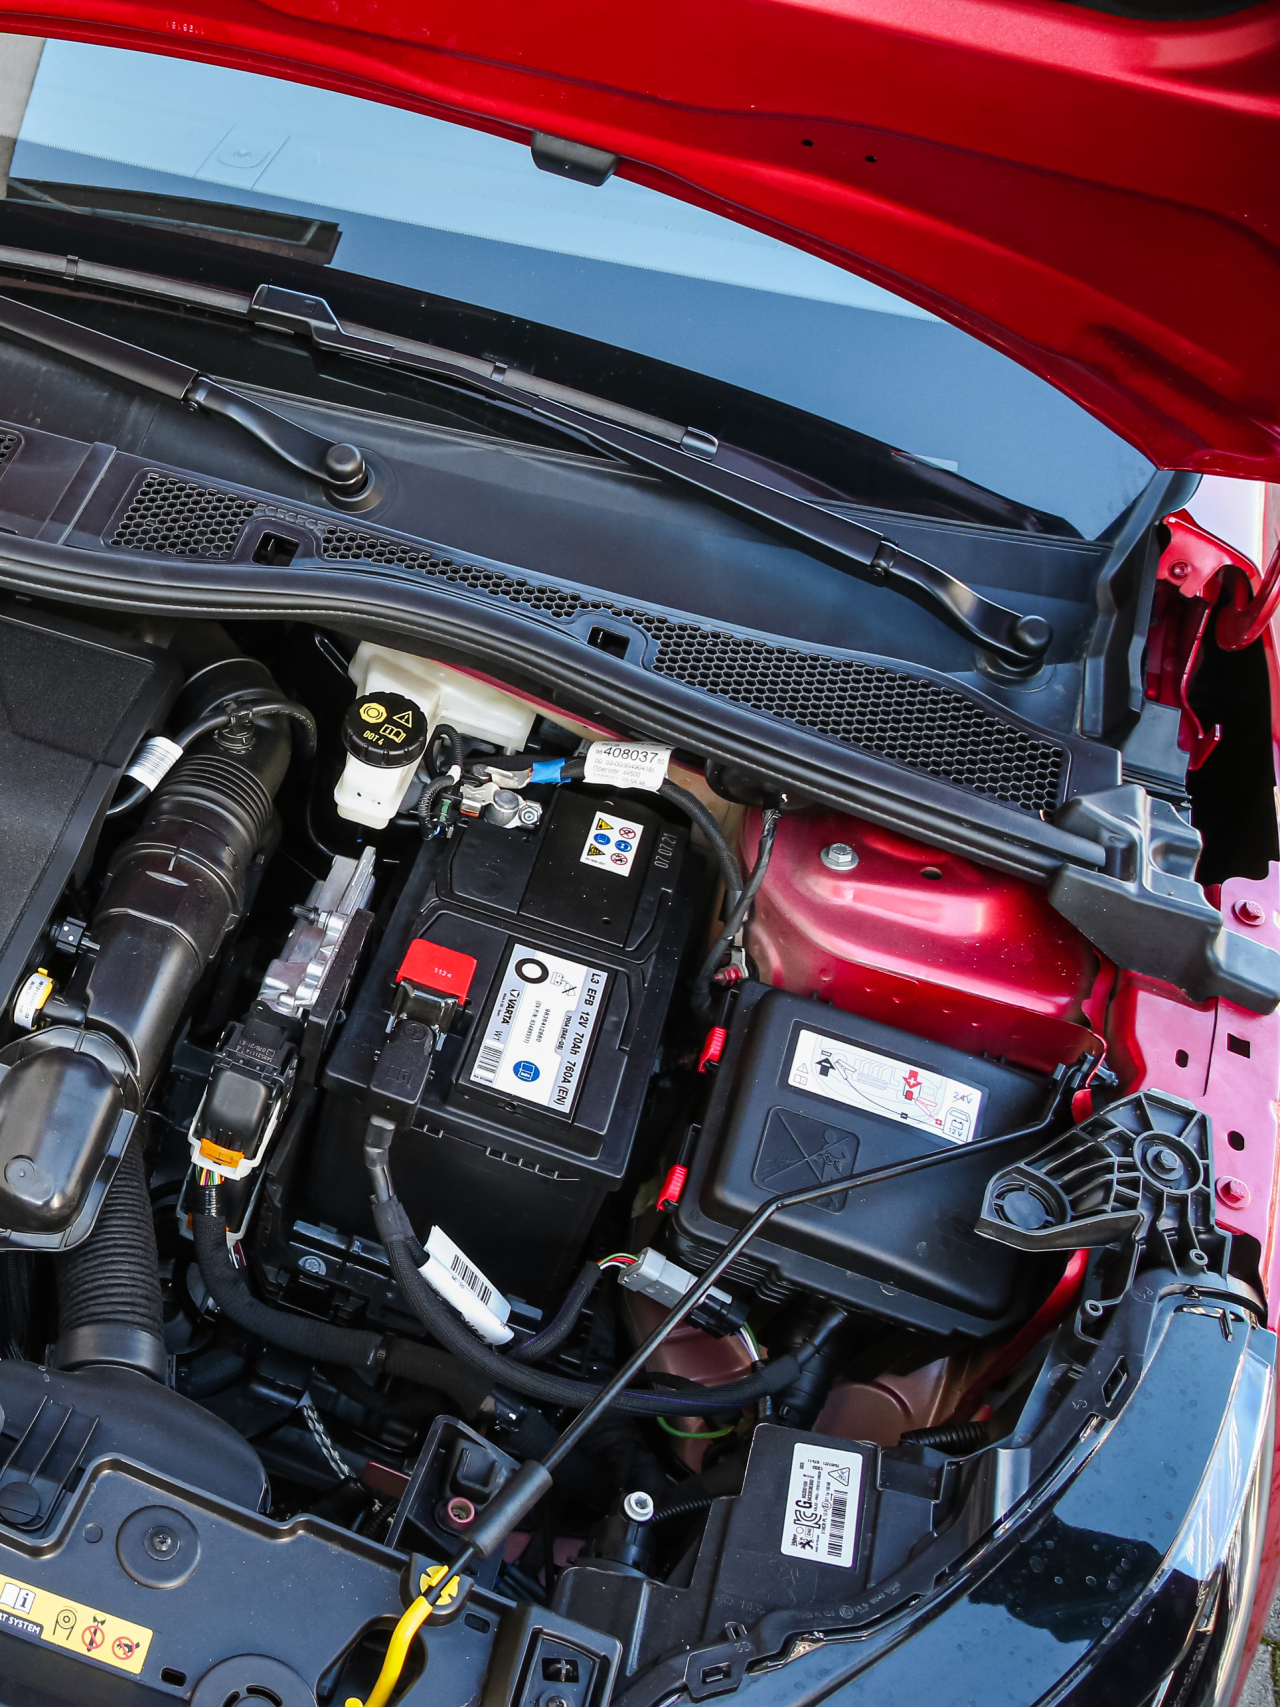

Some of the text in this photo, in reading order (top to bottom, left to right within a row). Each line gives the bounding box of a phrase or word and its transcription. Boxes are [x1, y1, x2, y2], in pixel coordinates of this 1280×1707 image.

[363, 730, 385, 746] DOT 4
[603, 747, 659, 763] 408037
[654, 833, 678, 869] 07.07.21
[500, 997, 516, 1024] VARTA
[492, 1029, 502, 1041] W1
[552, 972, 601, 1106] L3 EFB 12V 70Ah 760A (EN)
[8, 1616, 40, 1634] SYSTEM
